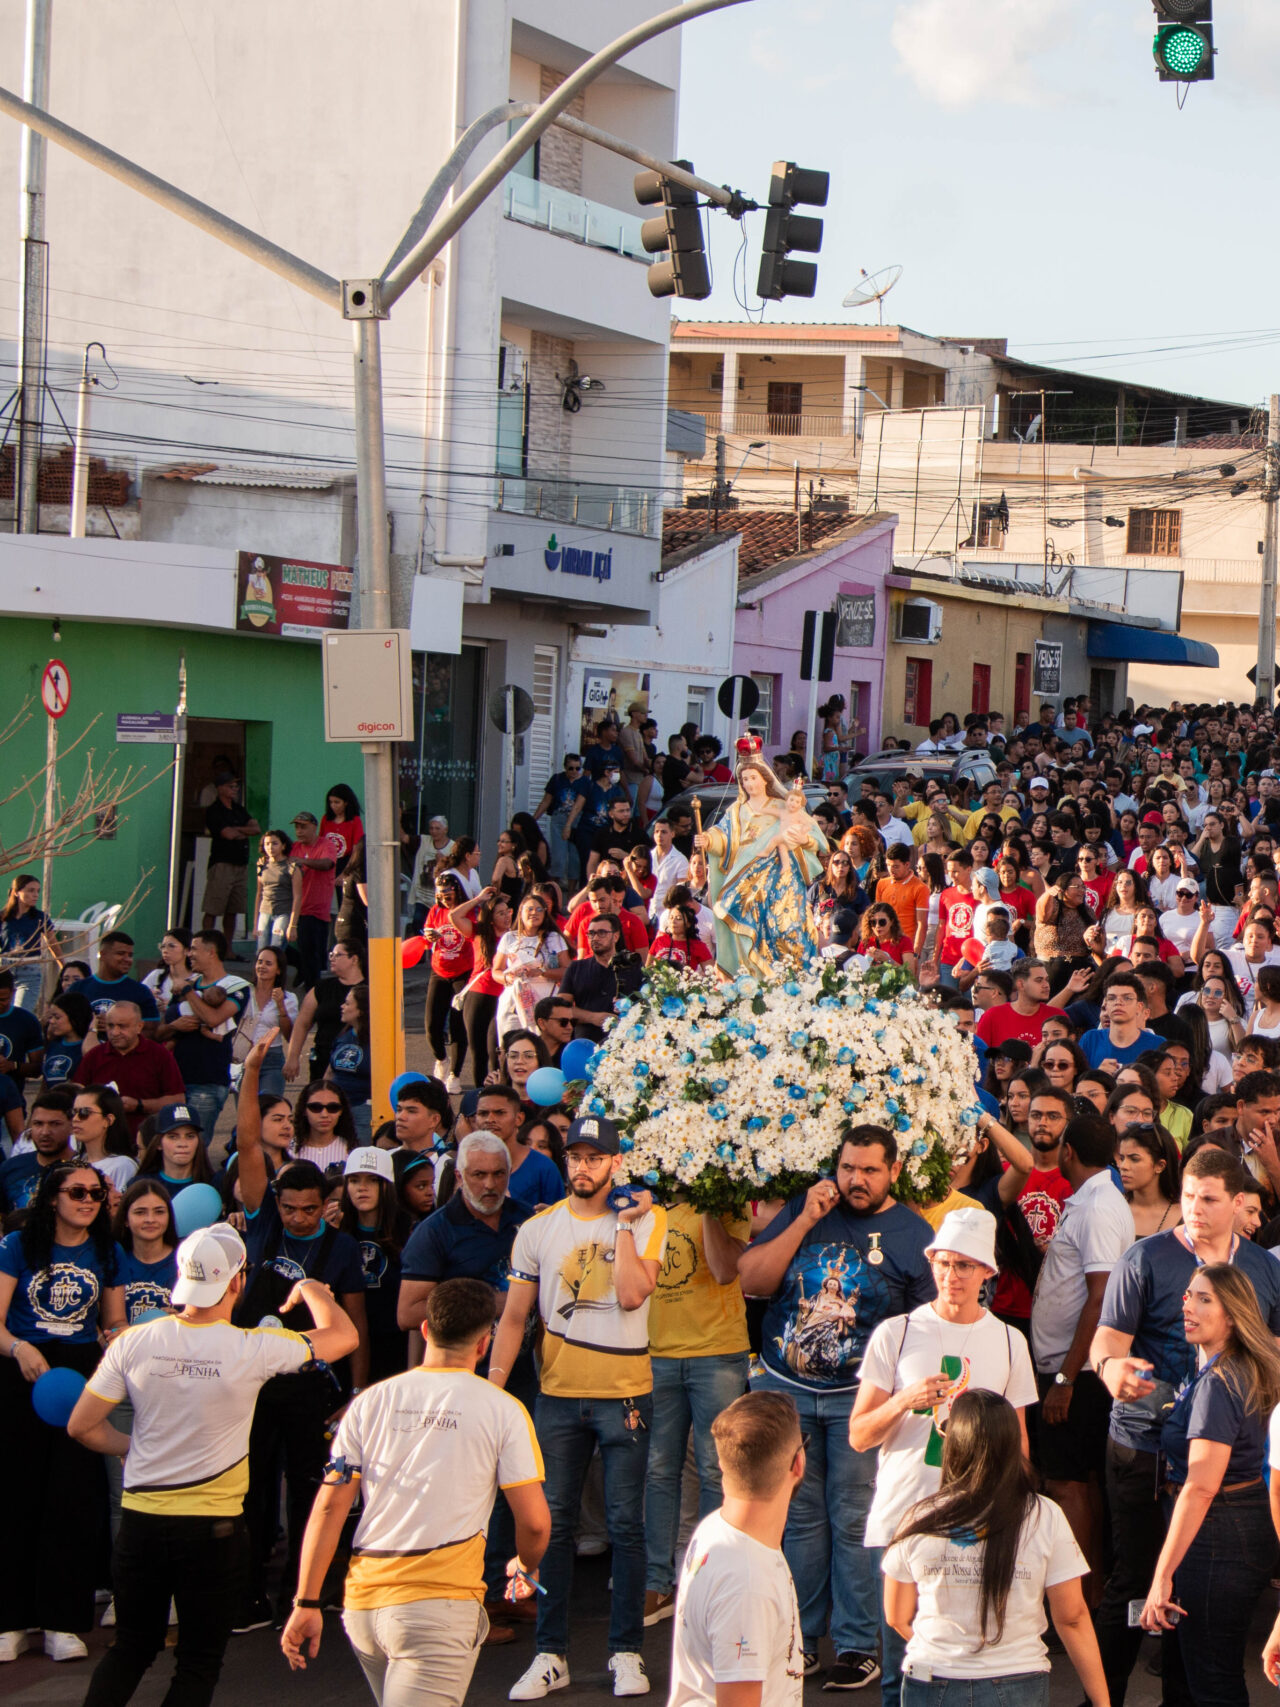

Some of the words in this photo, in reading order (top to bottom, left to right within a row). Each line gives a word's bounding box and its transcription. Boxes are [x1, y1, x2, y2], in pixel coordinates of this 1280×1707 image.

[281, 564, 329, 590] MATHEUS
[357, 722, 395, 733] digicon
[181, 1364, 220, 1377] PENHA
